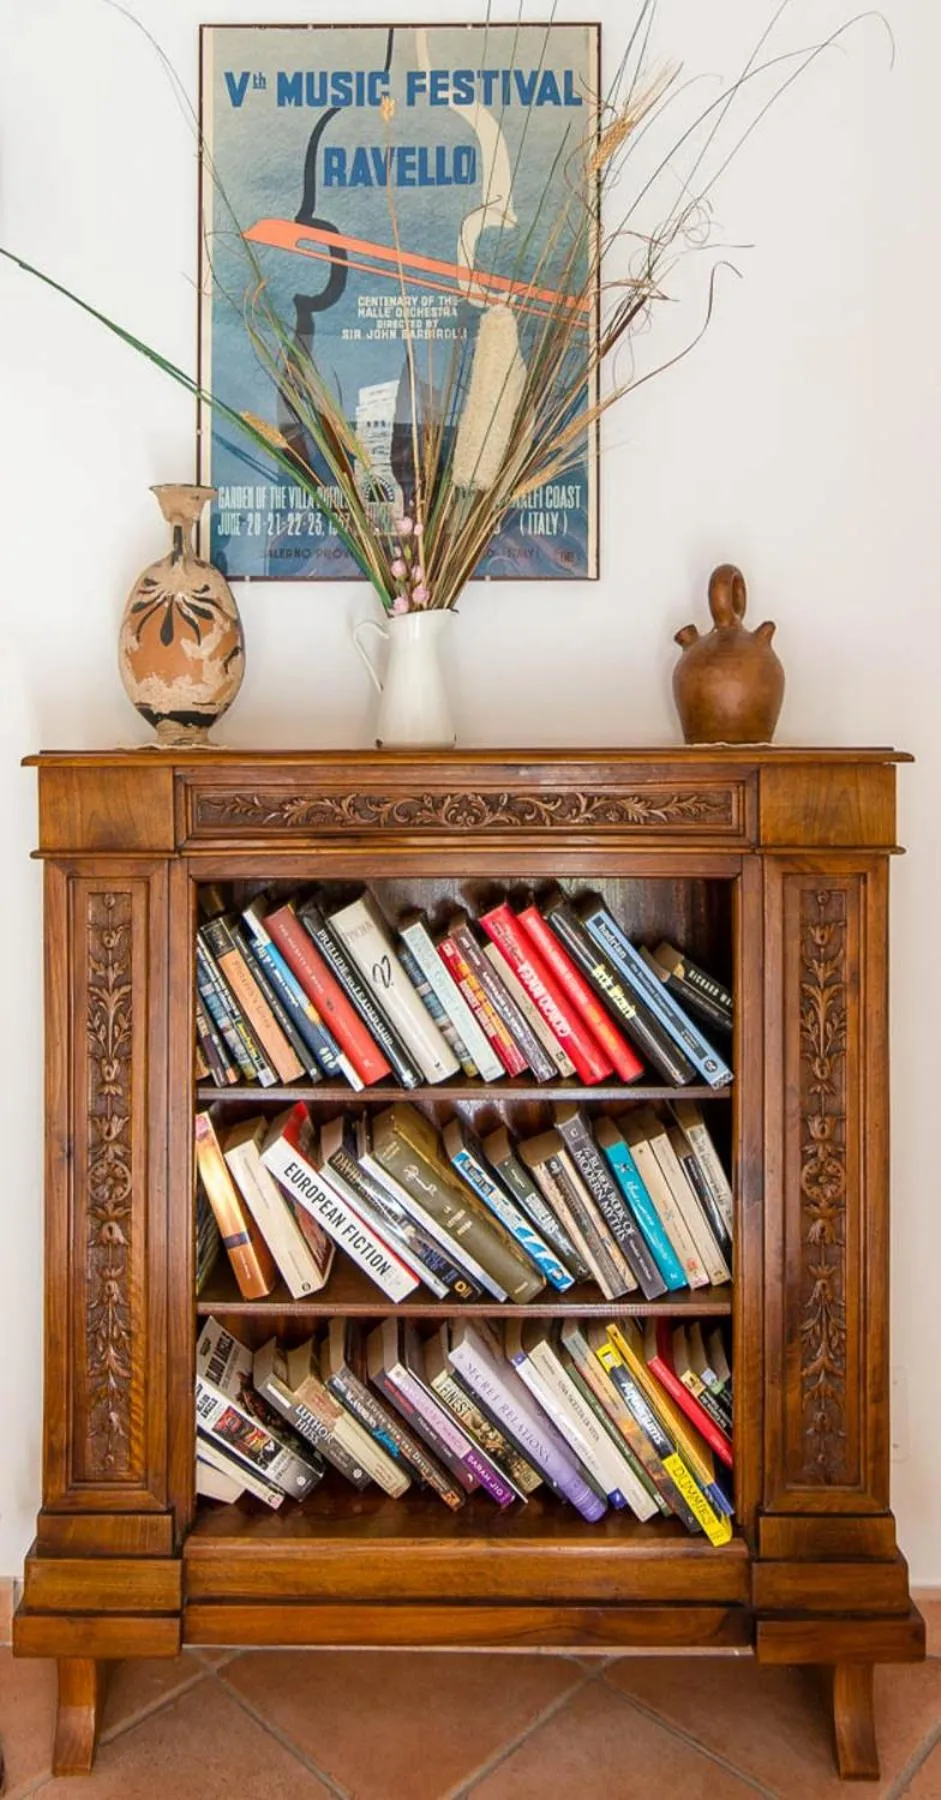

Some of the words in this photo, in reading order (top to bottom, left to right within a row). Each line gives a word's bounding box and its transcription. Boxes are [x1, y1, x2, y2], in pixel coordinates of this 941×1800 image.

[277, 70, 391, 107] MUSIC
[406, 69, 583, 106] FESTIVAL
[323, 145, 476, 187] RAVELLO
[395, 306, 457, 317] OCHESTRA
[420, 296, 434, 306] OF
[341, 329, 361, 340] SIR
[366, 329, 397, 340] JOHN
[426, 319, 439, 329] BY
[218, 486, 254, 509] GARDEN
[256, 486, 266, 509] OF
[270, 486, 287, 509] THE
[545, 485, 581, 508] COAST
[596, 922, 629, 959] hadrian
[315, 928, 350, 974] PRELUDE
[351, 985, 395, 1046] LEADERSHIP
[572, 1149, 607, 1200] MODERN
[599, 1199, 628, 1241] MYTHS
[586, 1155, 614, 1192] BLACK
[605, 1190, 628, 1221] BOOK
[620, 1219, 635, 1236] OF
[282, 1161, 347, 1228] EUROPEAN
[340, 1223, 392, 1276] FICTION
[293, 1418, 321, 1445] HUSS
[294, 1403, 335, 1444] LUTHOR
[463, 1361, 500, 1402] SECRET
[498, 1402, 553, 1463] RELATIONS
[616, 1377, 668, 1446] Aquariums
[465, 1453, 491, 1481] SARAH
[488, 1479, 505, 1497] JIO
[671, 1464, 716, 1526] DUMMIES
